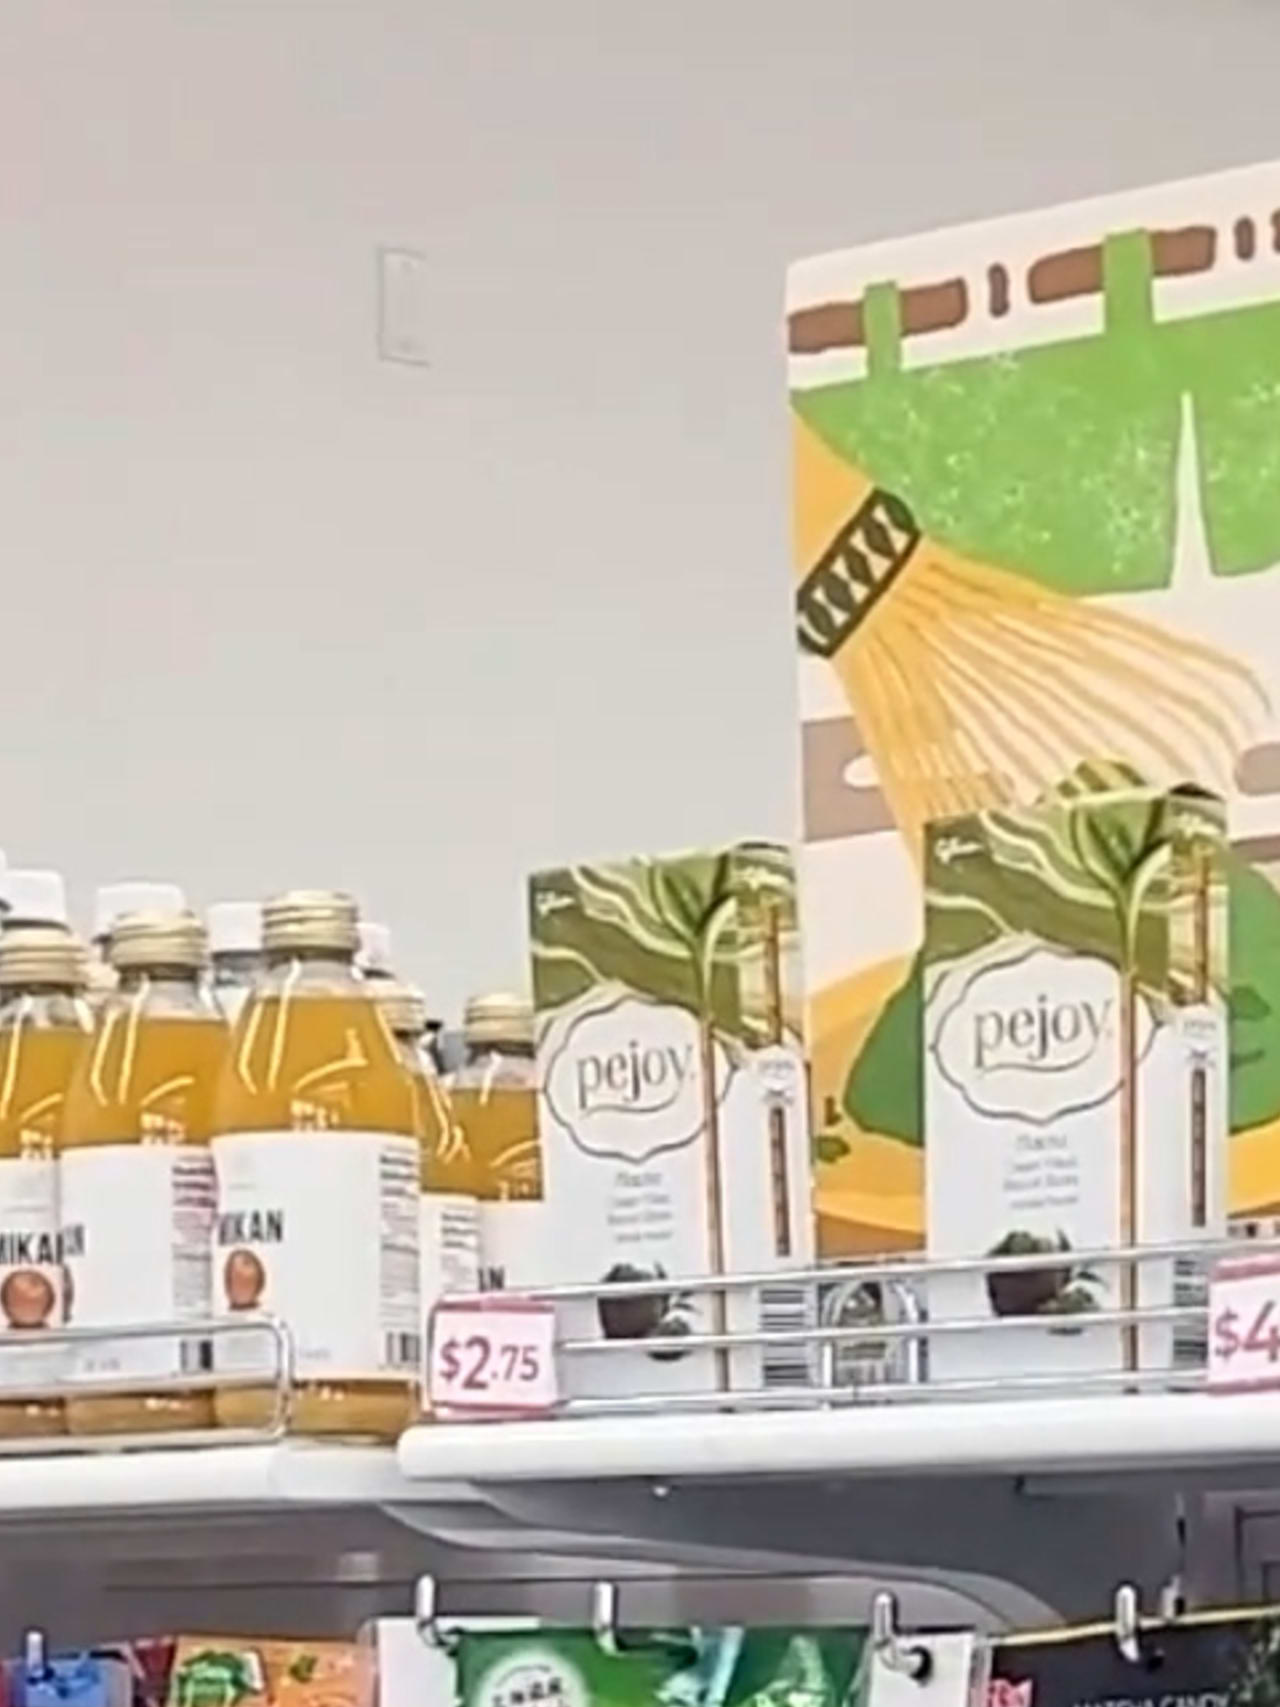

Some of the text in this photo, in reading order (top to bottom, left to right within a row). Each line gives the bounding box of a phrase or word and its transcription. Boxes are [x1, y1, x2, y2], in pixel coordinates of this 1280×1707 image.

[974, 992, 1108, 1070] pejoy
[575, 1041, 695, 1111] pejoy
[439, 1334, 539, 1391] $2.75
